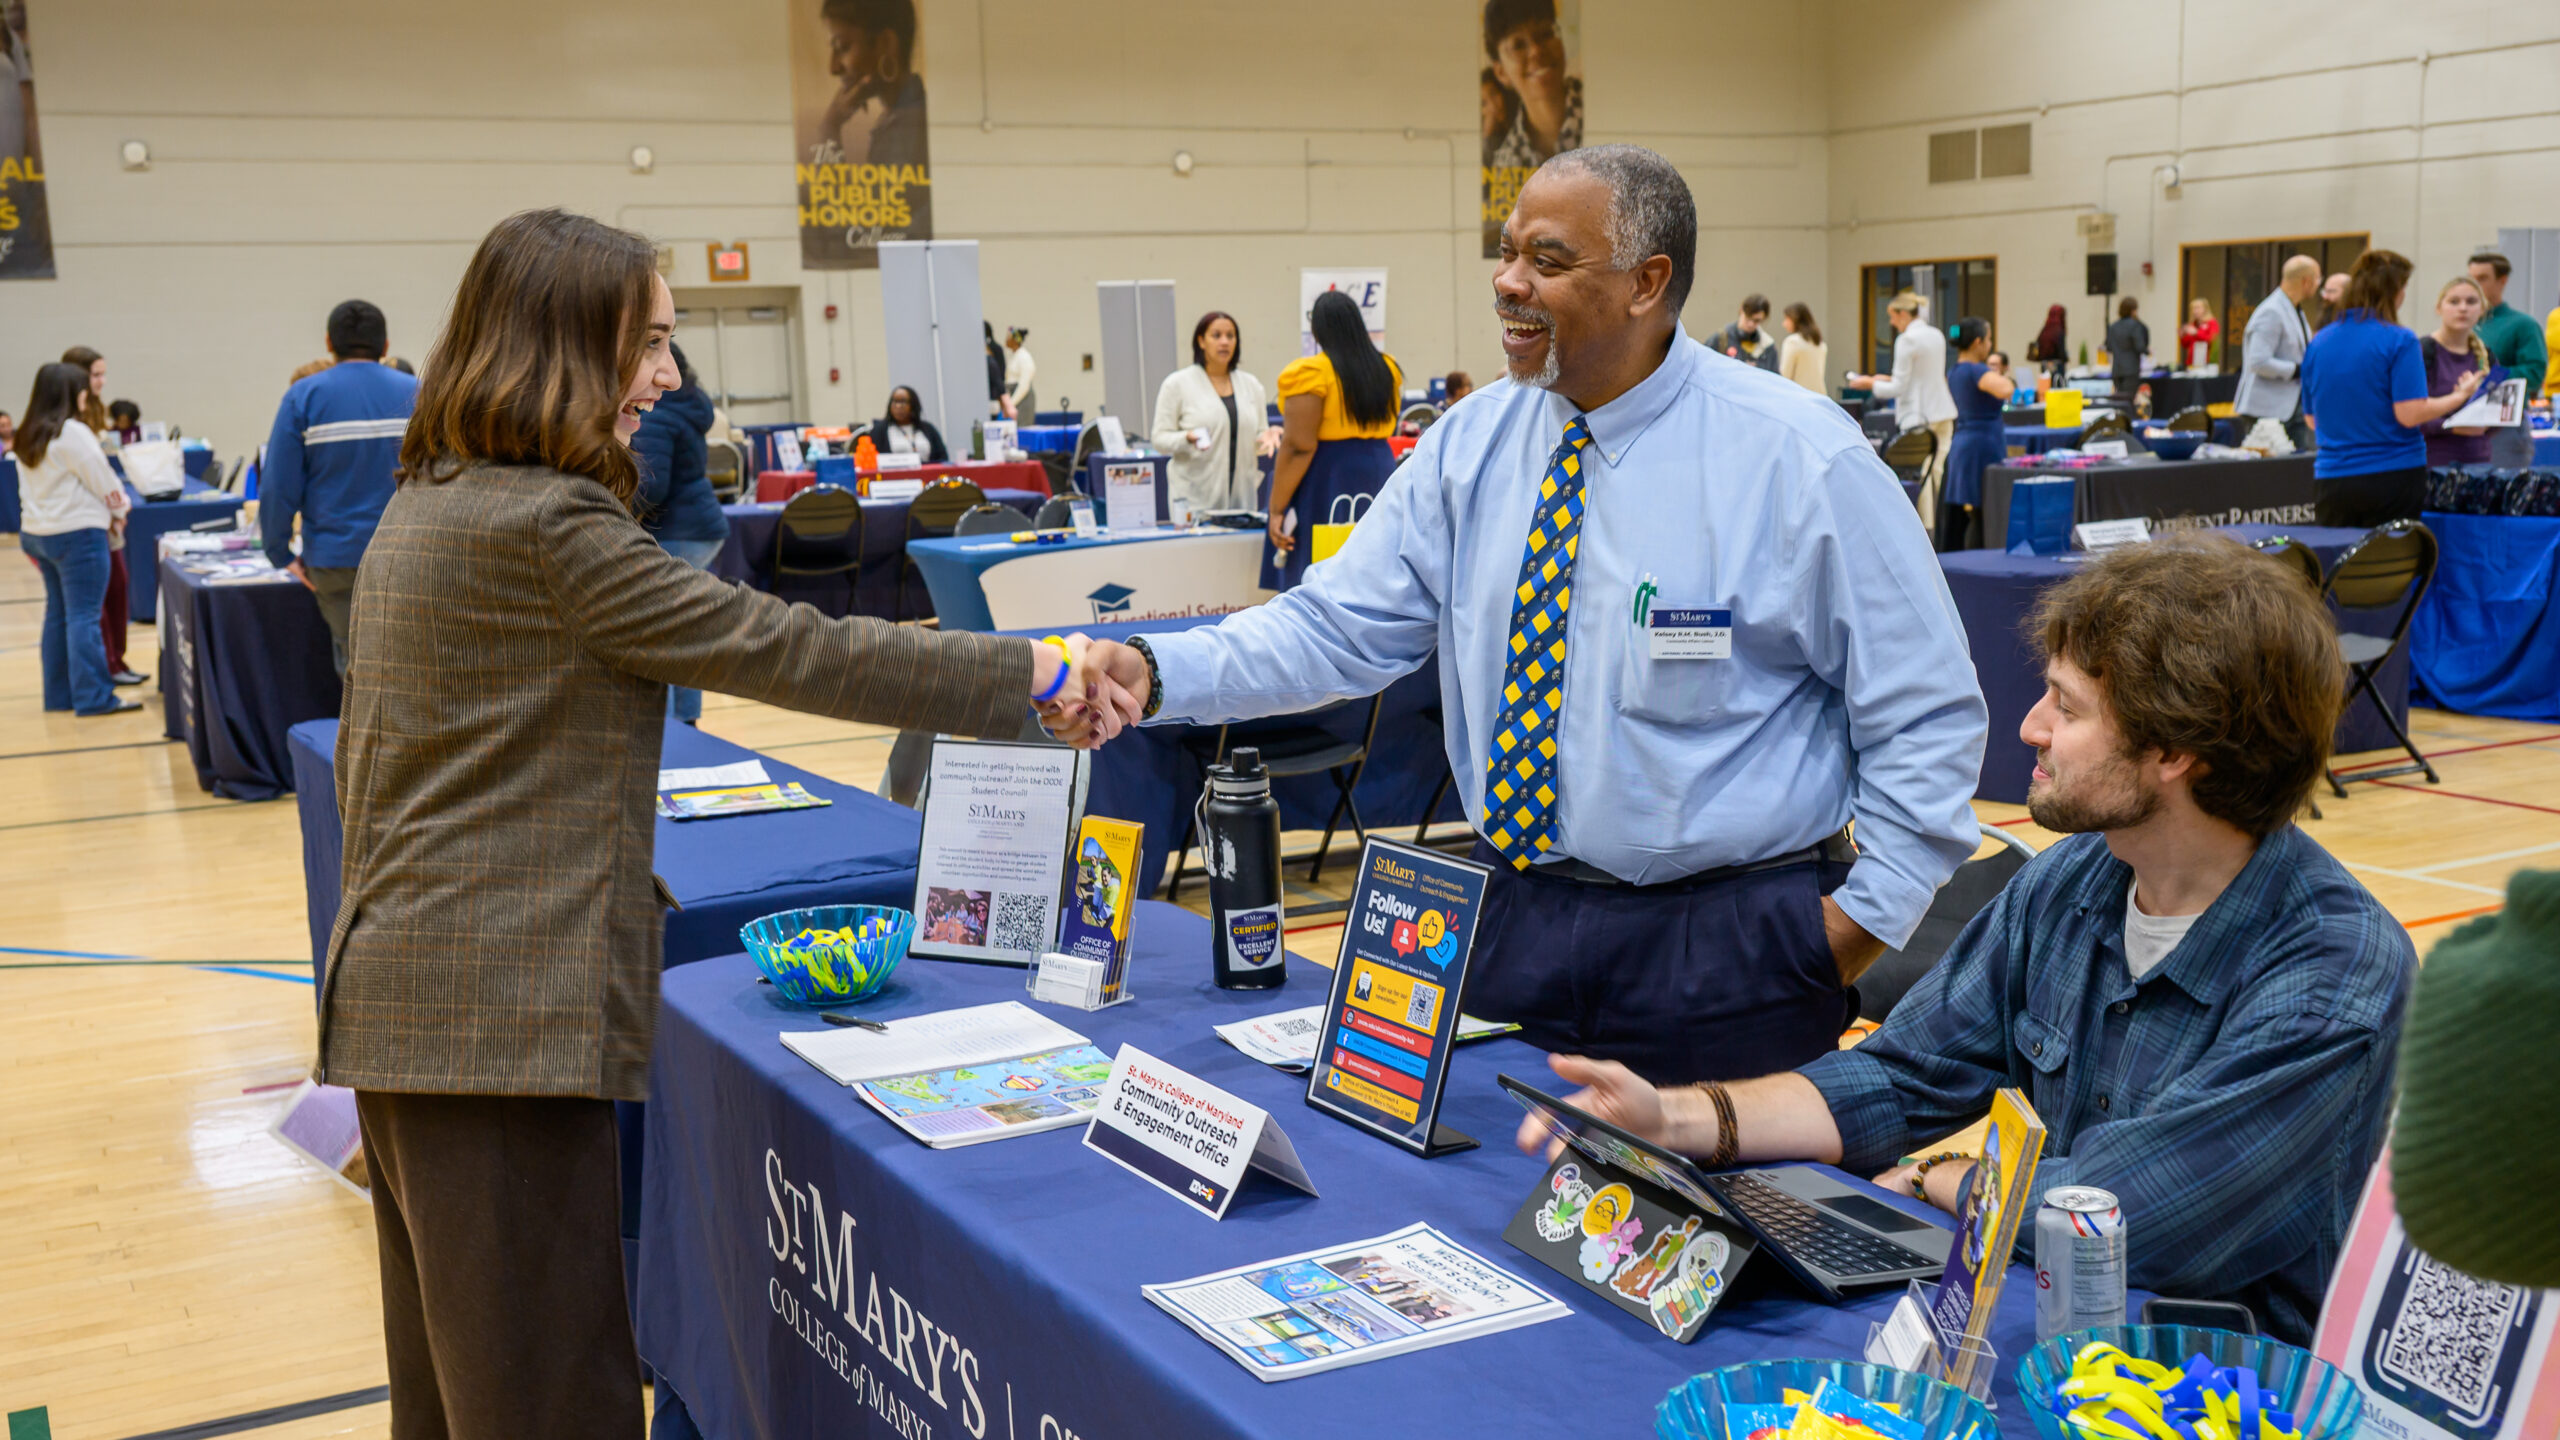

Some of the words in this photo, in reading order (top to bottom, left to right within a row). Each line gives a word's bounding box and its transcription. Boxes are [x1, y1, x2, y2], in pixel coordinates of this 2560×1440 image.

[810, 139, 845, 165] The
[796, 164, 932, 186] NATIONAL
[809, 184, 906, 207] PUBLIC
[798, 204, 912, 228] HONORS
[944, 760, 980, 769] Interested
[982, 761, 988, 769] in
[990, 762, 1014, 773] getting
[1016, 763, 1045, 773] involved
[1046, 766, 1061, 774] with
[940, 773, 976, 783] community
[978, 775, 1012, 784] outreach?
[1030, 777, 1041, 785] the
[971, 786, 998, 795] Student
[1368, 889, 1418, 922] Follow
[1233, 922, 1277, 935] CERTIFIED
[1363, 911, 1388, 937] Us!
[1073, 942, 1111, 956] COMMUNITY
[1080, 935, 1101, 948] OFFICE
[1102, 939, 1112, 948] OF
[1238, 939, 1275, 950] EXCELLENT
[1243, 946, 1272, 956] SERVICE
[1127, 1064, 1138, 1077] St.
[1139, 1069, 1164, 1090] Mary's
[1164, 1083, 1195, 1106] College
[1196, 1098, 1206, 1109] of
[1205, 1102, 1244, 1130] Maryland
[1121, 1078, 1184, 1123] Community
[1185, 1111, 1238, 1149] Outreach
[1113, 1096, 1123, 1111] &
[1123, 1102, 1194, 1149] Engagement
[1194, 1138, 1230, 1168] Office
[1433, 1247, 1494, 1281] WELCOME
[1488, 1279, 1511, 1291] TO
[769, 1277, 851, 1383] COLLEGE
[853, 1363, 867, 1405] of
